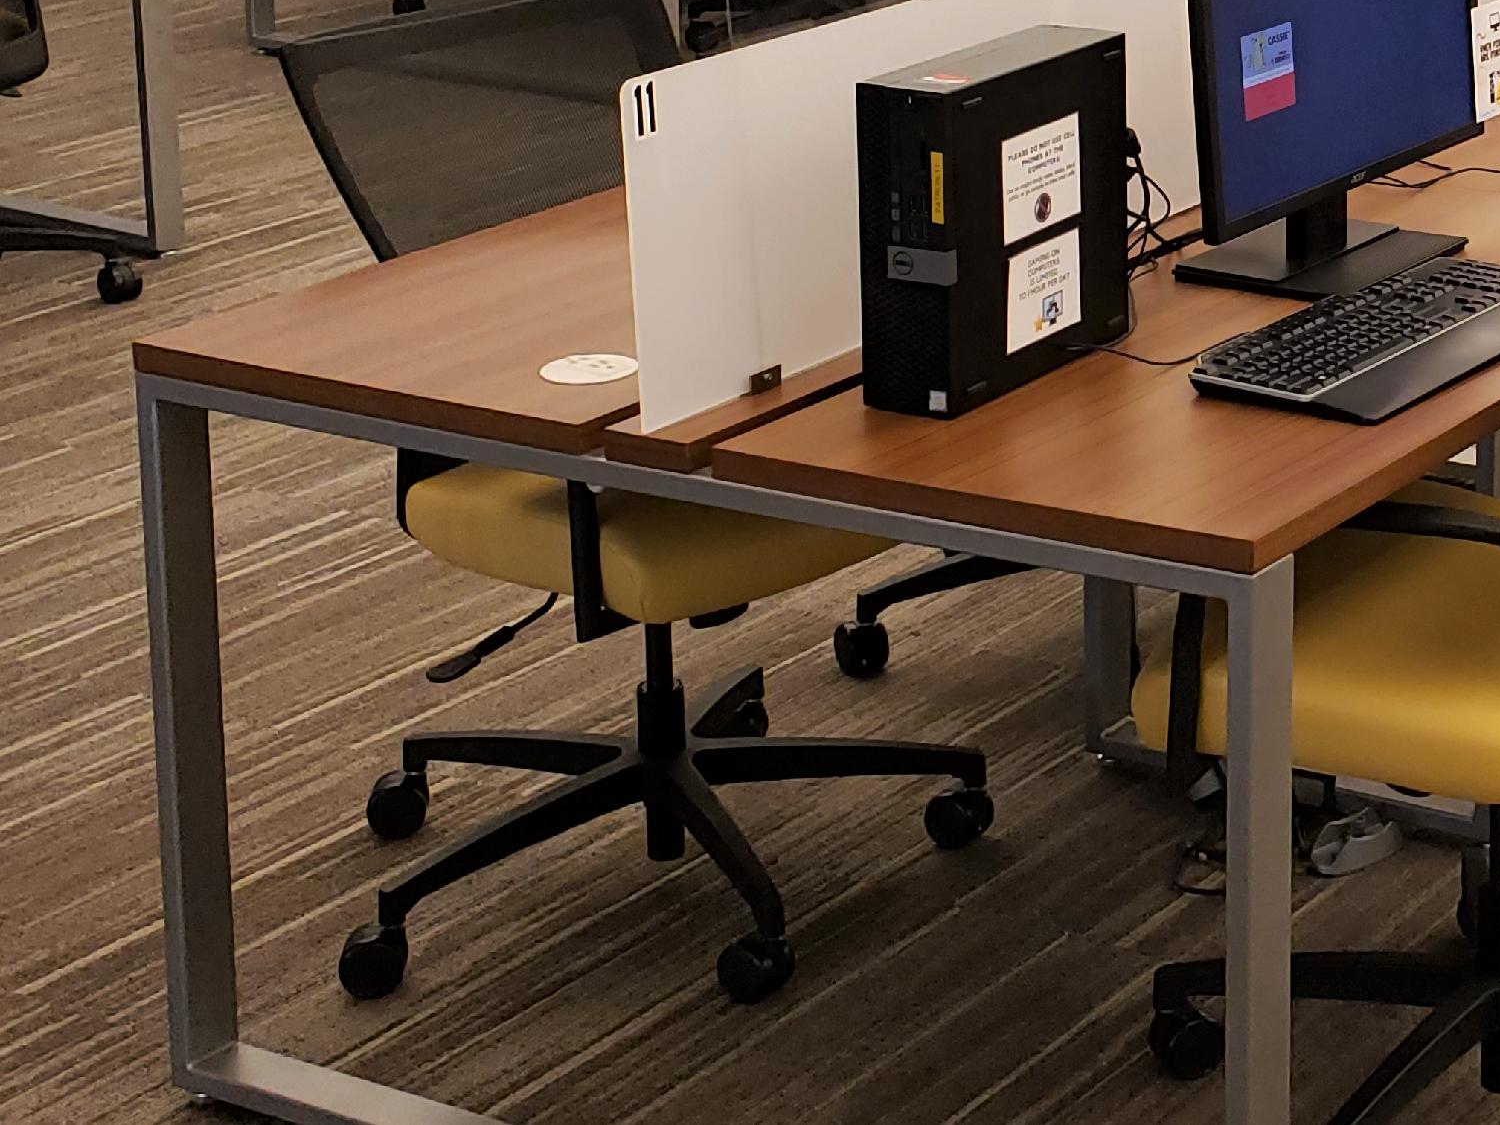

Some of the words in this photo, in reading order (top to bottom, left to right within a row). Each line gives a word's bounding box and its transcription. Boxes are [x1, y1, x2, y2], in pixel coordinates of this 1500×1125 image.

[1267, 30, 1290, 46] CASSIE
[633, 80, 658, 137] 11
[1007, 148, 1029, 162] PLEASE
[1030, 144, 1038, 154] DO
[1038, 139, 1051, 149] NOT
[1027, 256, 1060, 278] COMPUTERS
[1047, 277, 1058, 288] PER
